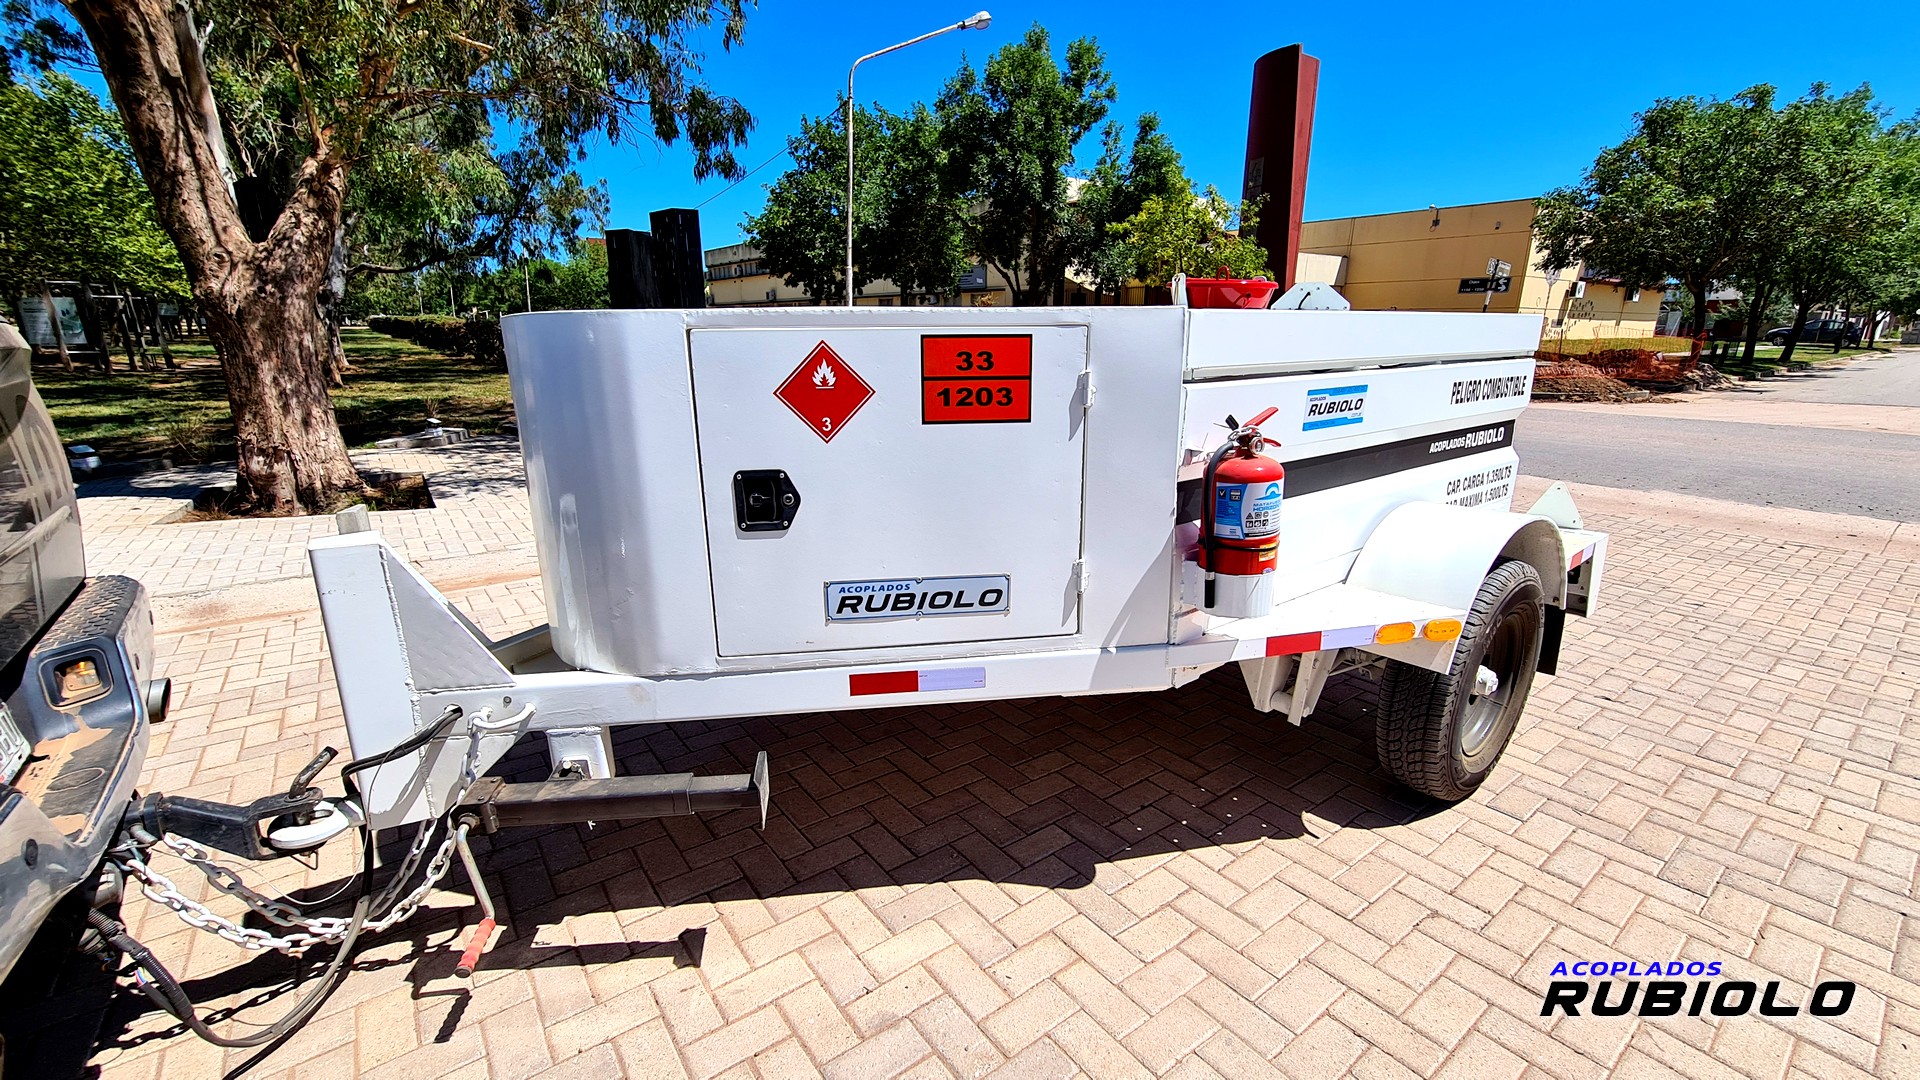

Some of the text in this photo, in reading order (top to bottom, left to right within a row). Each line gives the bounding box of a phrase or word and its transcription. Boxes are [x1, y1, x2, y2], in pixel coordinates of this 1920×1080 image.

[955, 350, 994, 371] 33
[936, 387, 1014, 407] 1203
[1450, 375, 1527, 405] PELIGRO COMBUSTIBLE
[1307, 398, 1364, 417] RUBIOLO
[821, 417, 832, 432] 3
[1428, 426, 1505, 454] ACOPLADOS RUBIOLO
[1446, 479, 1461, 496] CAP.
[1462, 472, 1485, 491] CARGA
[838, 583, 911, 594] ACOPLADOS
[835, 588, 1004, 614] RUBIOLO
